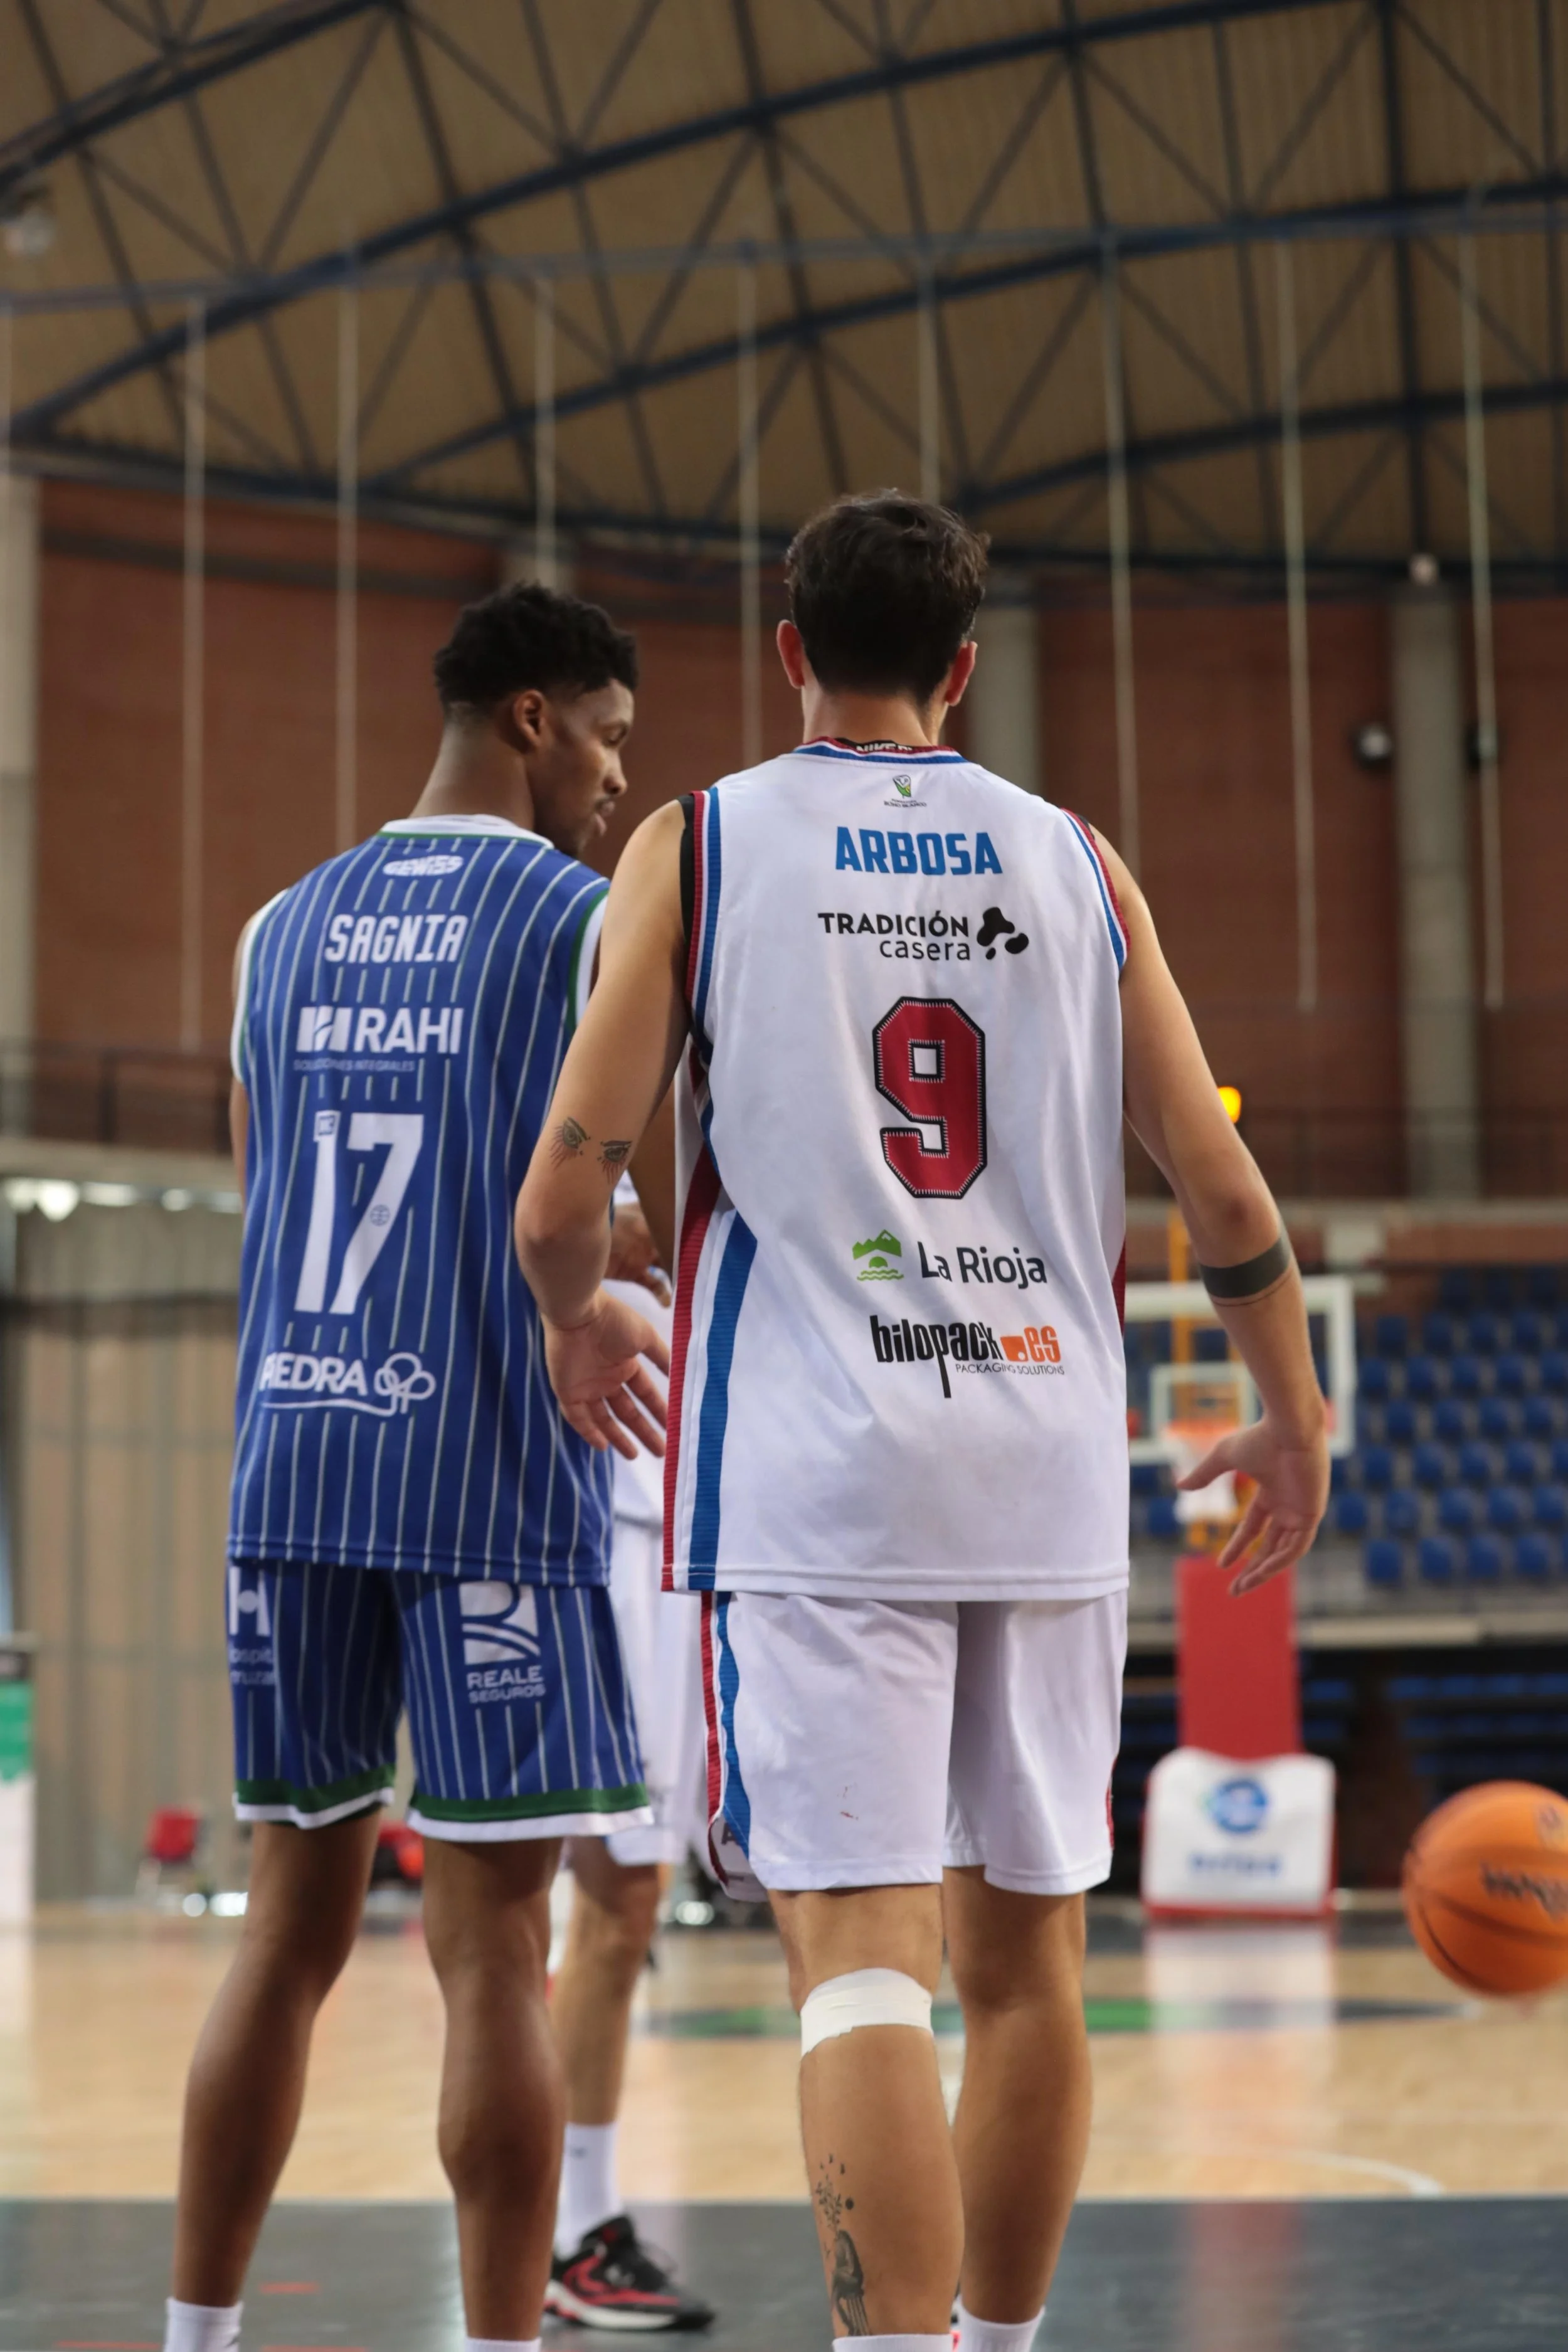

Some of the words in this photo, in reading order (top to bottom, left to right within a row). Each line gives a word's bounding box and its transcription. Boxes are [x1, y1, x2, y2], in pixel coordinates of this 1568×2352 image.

[835, 826, 1003, 875] ARBOSA
[324, 914, 469, 963] SAGNIA
[818, 911, 969, 938] TRADICIÓN
[879, 940, 971, 960] casera
[353, 1007, 464, 1054] RAHI
[872, 996, 988, 1199] 9
[294, 1110, 425, 1315] 17
[917, 1241, 953, 1283] La
[956, 1246, 1047, 1290] Rioja
[955, 1362, 1016, 1374] PACKAGING
[1017, 1365, 1065, 1375] SOLUTIONS
[466, 1665, 544, 1690] REALE
